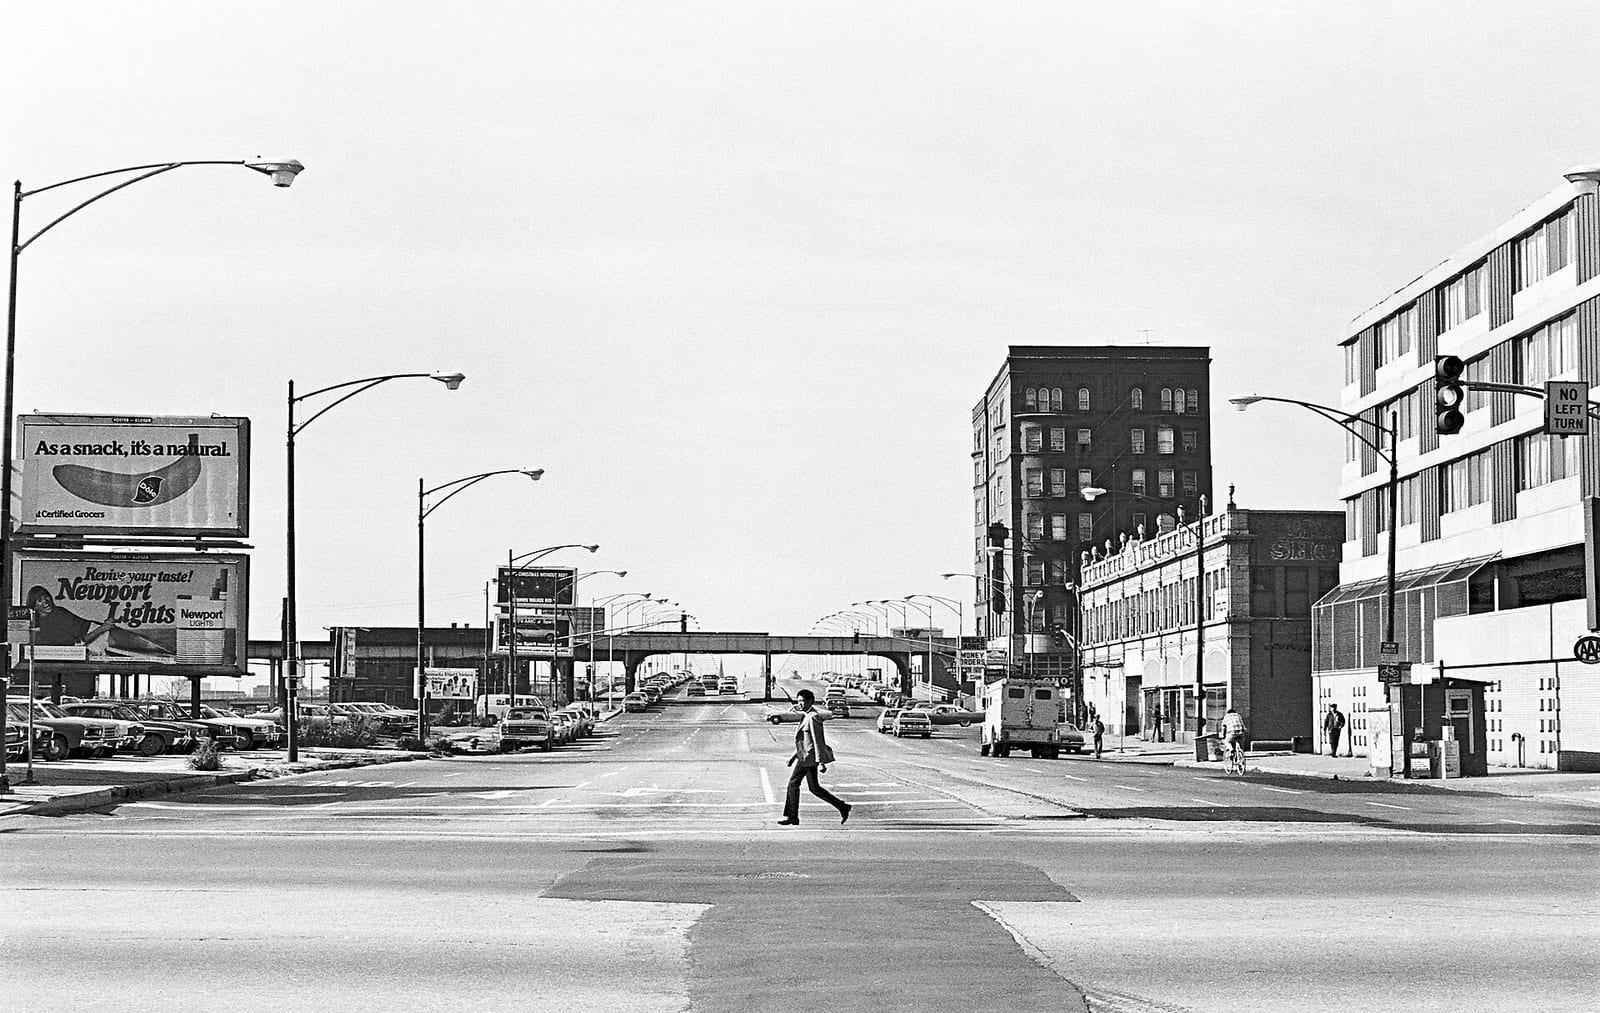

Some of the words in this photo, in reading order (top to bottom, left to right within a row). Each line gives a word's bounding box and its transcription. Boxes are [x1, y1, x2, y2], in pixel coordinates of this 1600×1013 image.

[1560, 388, 1578, 400] NO
[1555, 404, 1582, 414] LEFT
[1554, 418, 1583, 428] TURN
[35, 440, 58, 456] As
[60, 444, 71, 456] a
[73, 440, 129, 457] snack,
[131, 440, 151, 456] it's
[153, 444, 164, 456] a
[166, 441, 230, 457] natural.
[140, 482, 157, 498] Dole
[41, 510, 74, 518] Certified
[75, 510, 105, 518] Grocers
[84, 567, 126, 581] Revive
[126, 572, 157, 584] your
[157, 570, 194, 583] taste!
[55, 577, 153, 603] Newport
[104, 602, 176, 628] Lights
[181, 609, 223, 621] Newport
